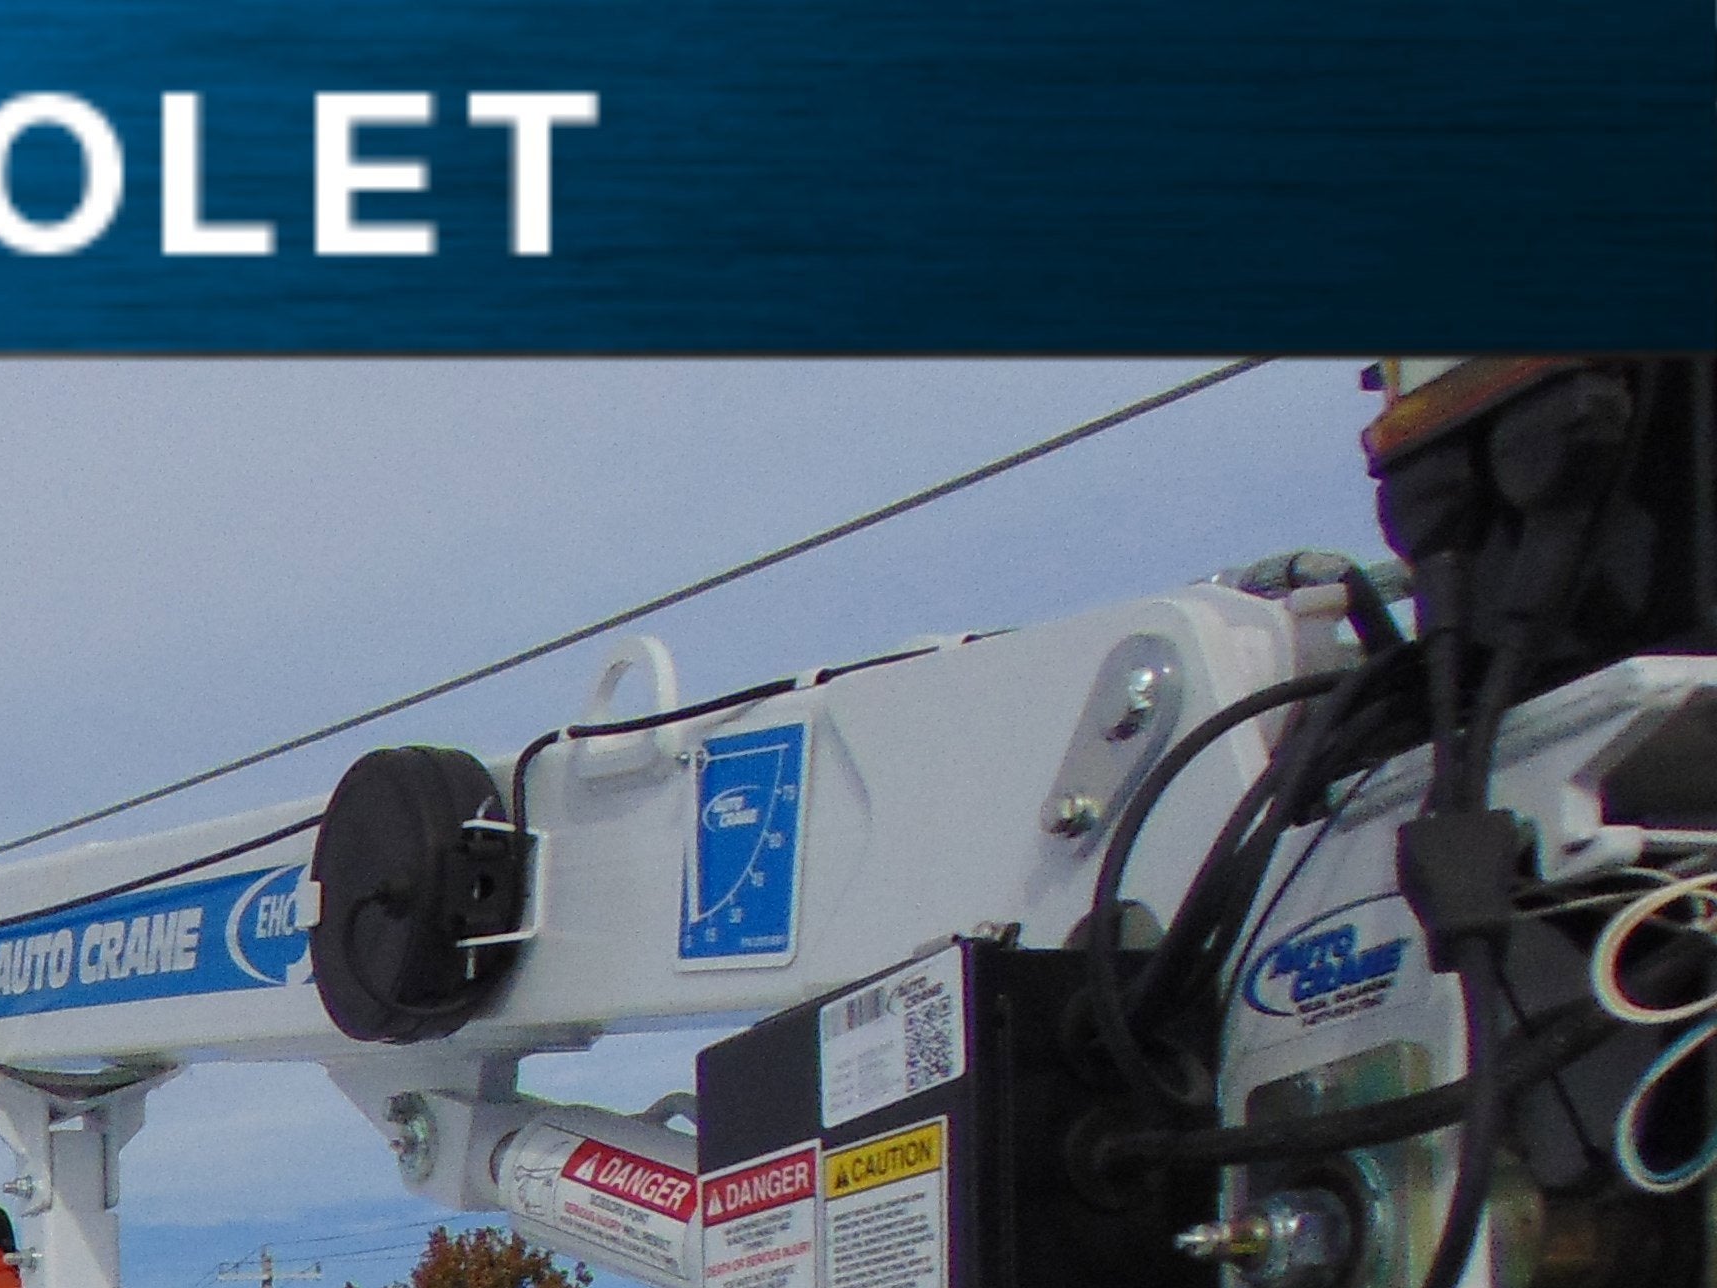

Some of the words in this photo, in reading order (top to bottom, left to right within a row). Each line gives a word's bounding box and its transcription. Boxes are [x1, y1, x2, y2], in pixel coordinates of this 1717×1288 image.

[78, 907, 204, 985] CRANE
[598, 1157, 691, 1211] DANGER
[853, 1137, 933, 1182] CAUTION
[726, 1161, 810, 1210] DANGER
